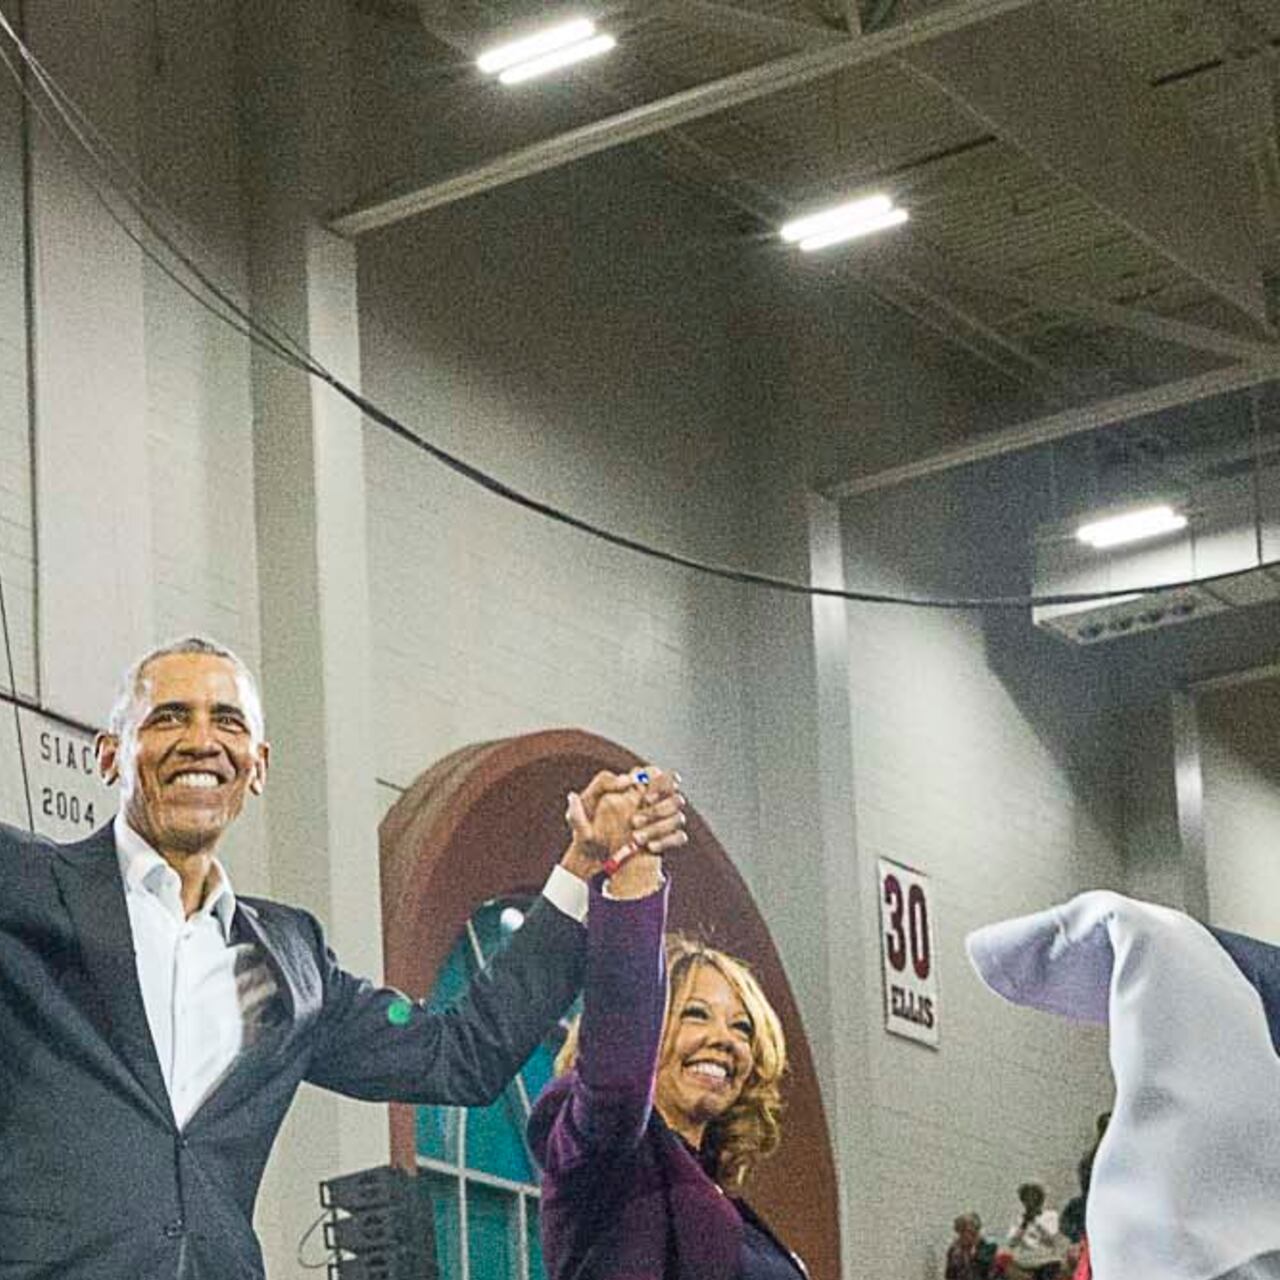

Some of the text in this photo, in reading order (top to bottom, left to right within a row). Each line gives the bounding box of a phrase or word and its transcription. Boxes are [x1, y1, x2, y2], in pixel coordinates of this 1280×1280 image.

[41, 731, 94, 776] SIAC
[43, 786, 95, 830] 2004
[883, 873, 931, 981] 30
[890, 985, 934, 1030] ELLIS
